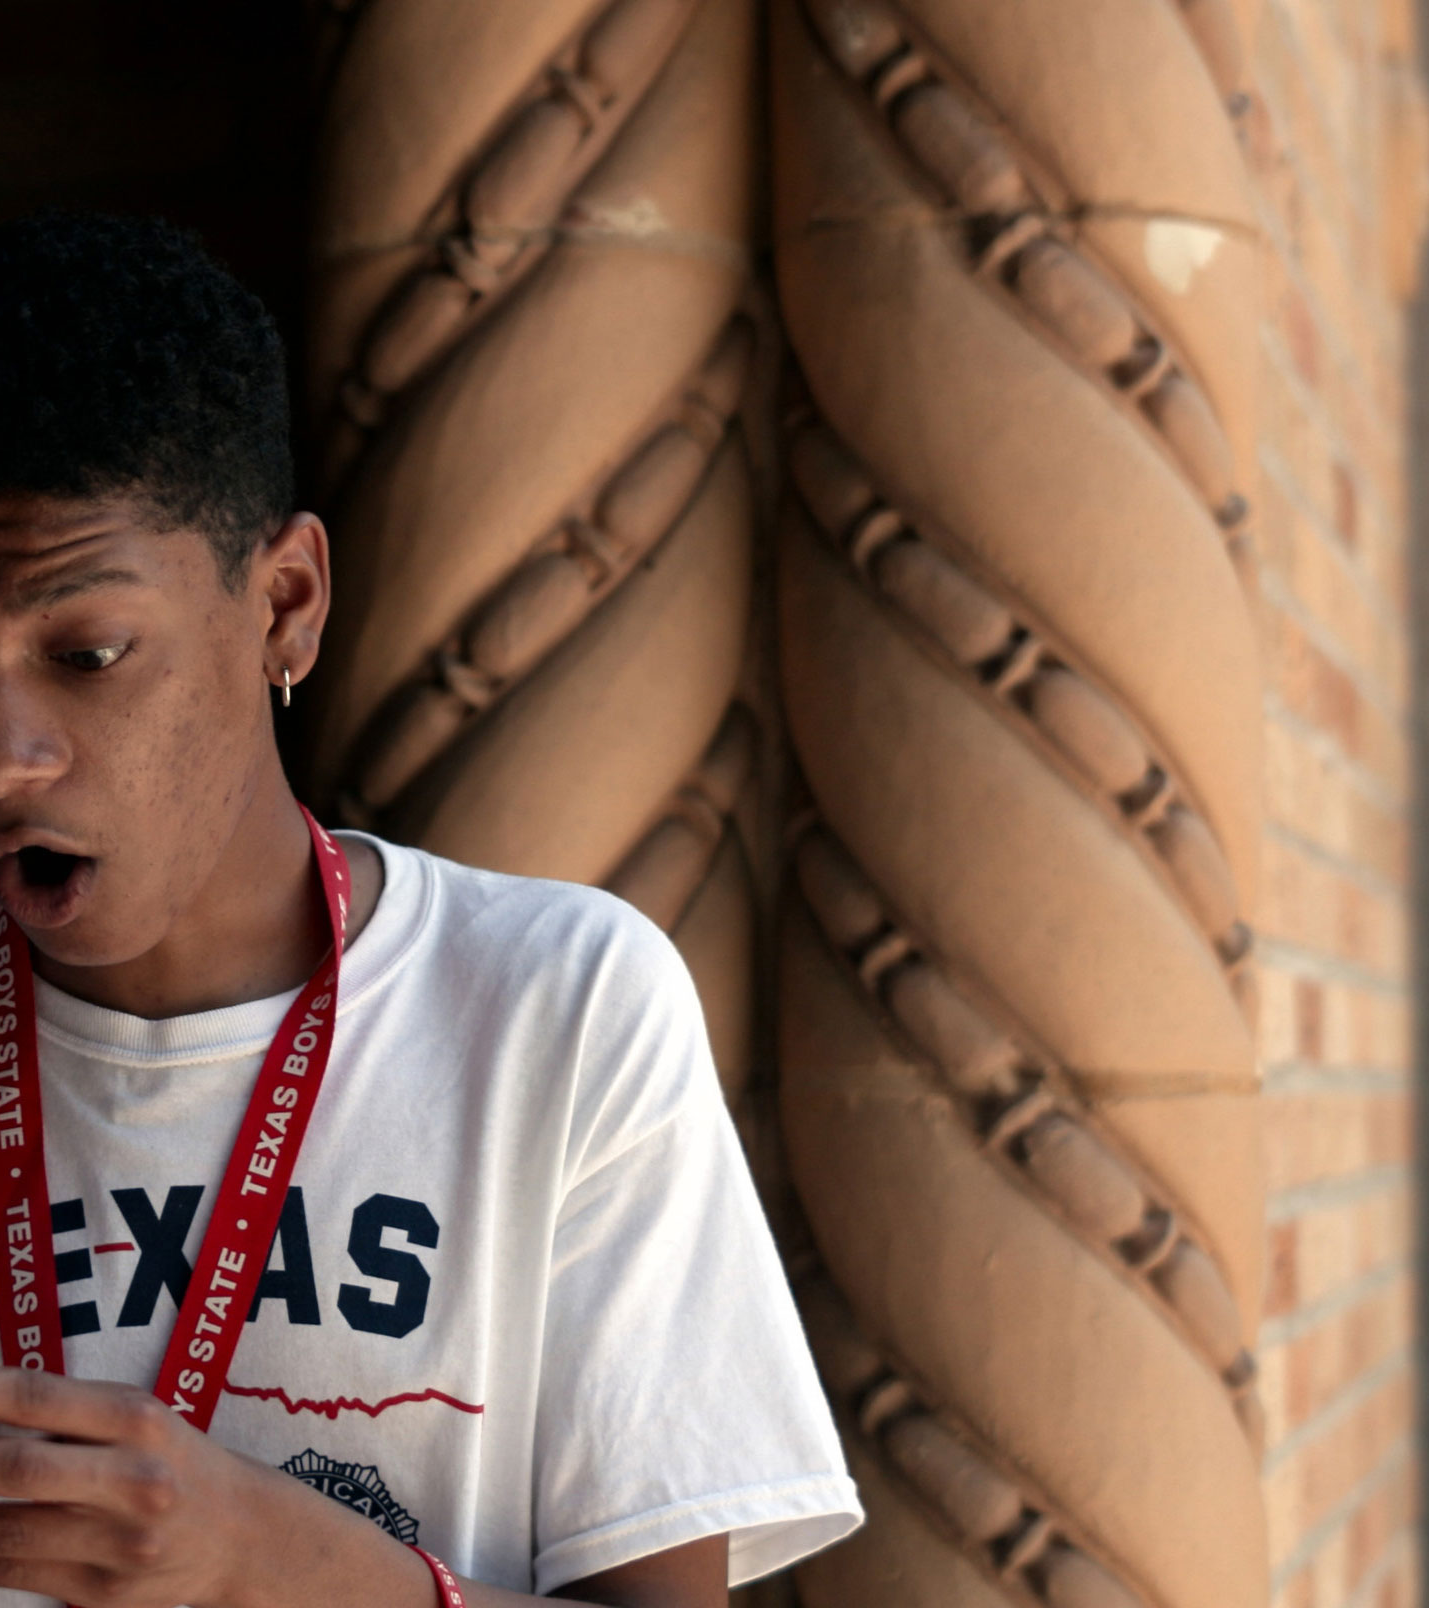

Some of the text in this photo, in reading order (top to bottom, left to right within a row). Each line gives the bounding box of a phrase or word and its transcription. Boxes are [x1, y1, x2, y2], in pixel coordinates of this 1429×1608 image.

[6, 1198, 39, 1315] TEXAS
[188, 1247, 247, 1363] STATE
[240, 1086, 299, 1196] TEXAS
[282, 993, 332, 1077] BOYS
